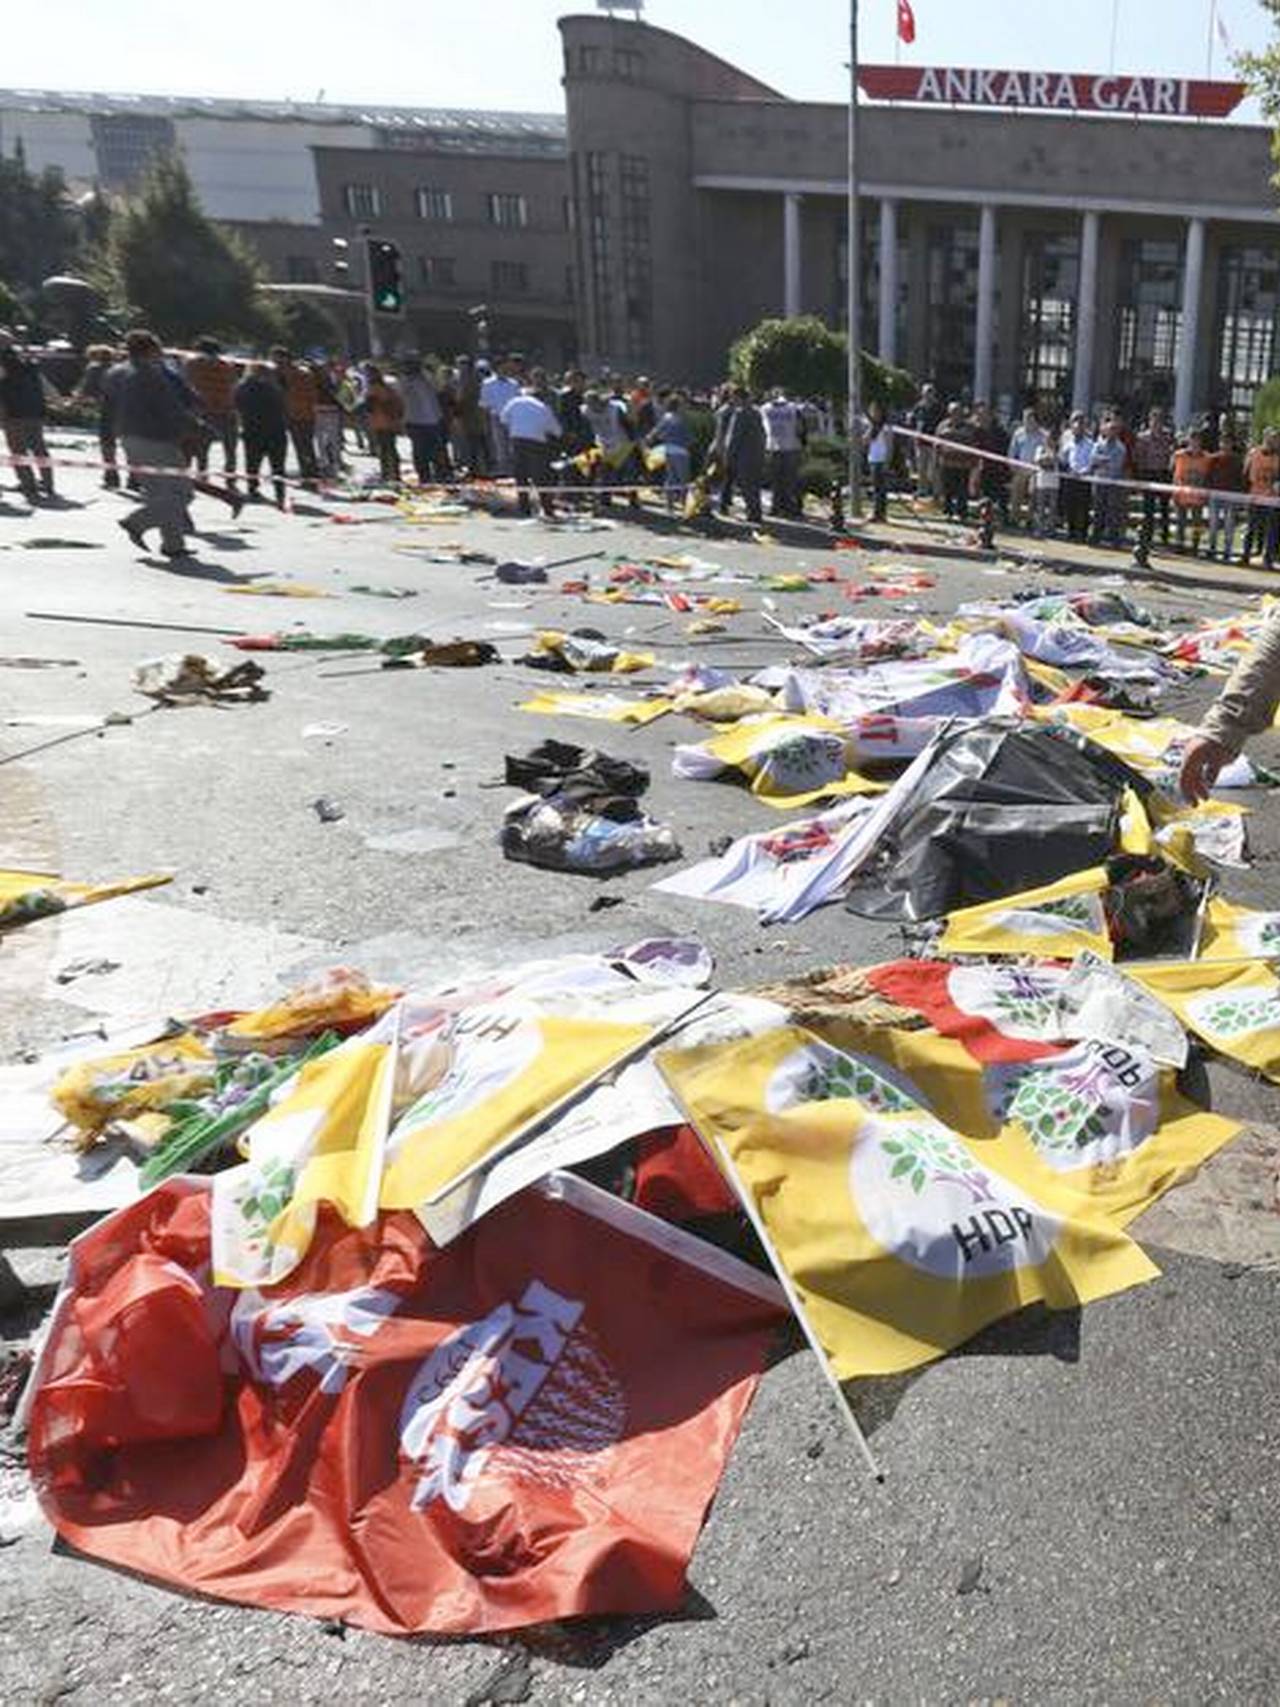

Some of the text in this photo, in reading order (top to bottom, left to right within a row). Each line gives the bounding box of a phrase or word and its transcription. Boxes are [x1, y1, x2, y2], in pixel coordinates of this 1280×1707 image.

[915, 67, 1188, 113] ANKARA GARI
[951, 1207, 1033, 1263] HDP
